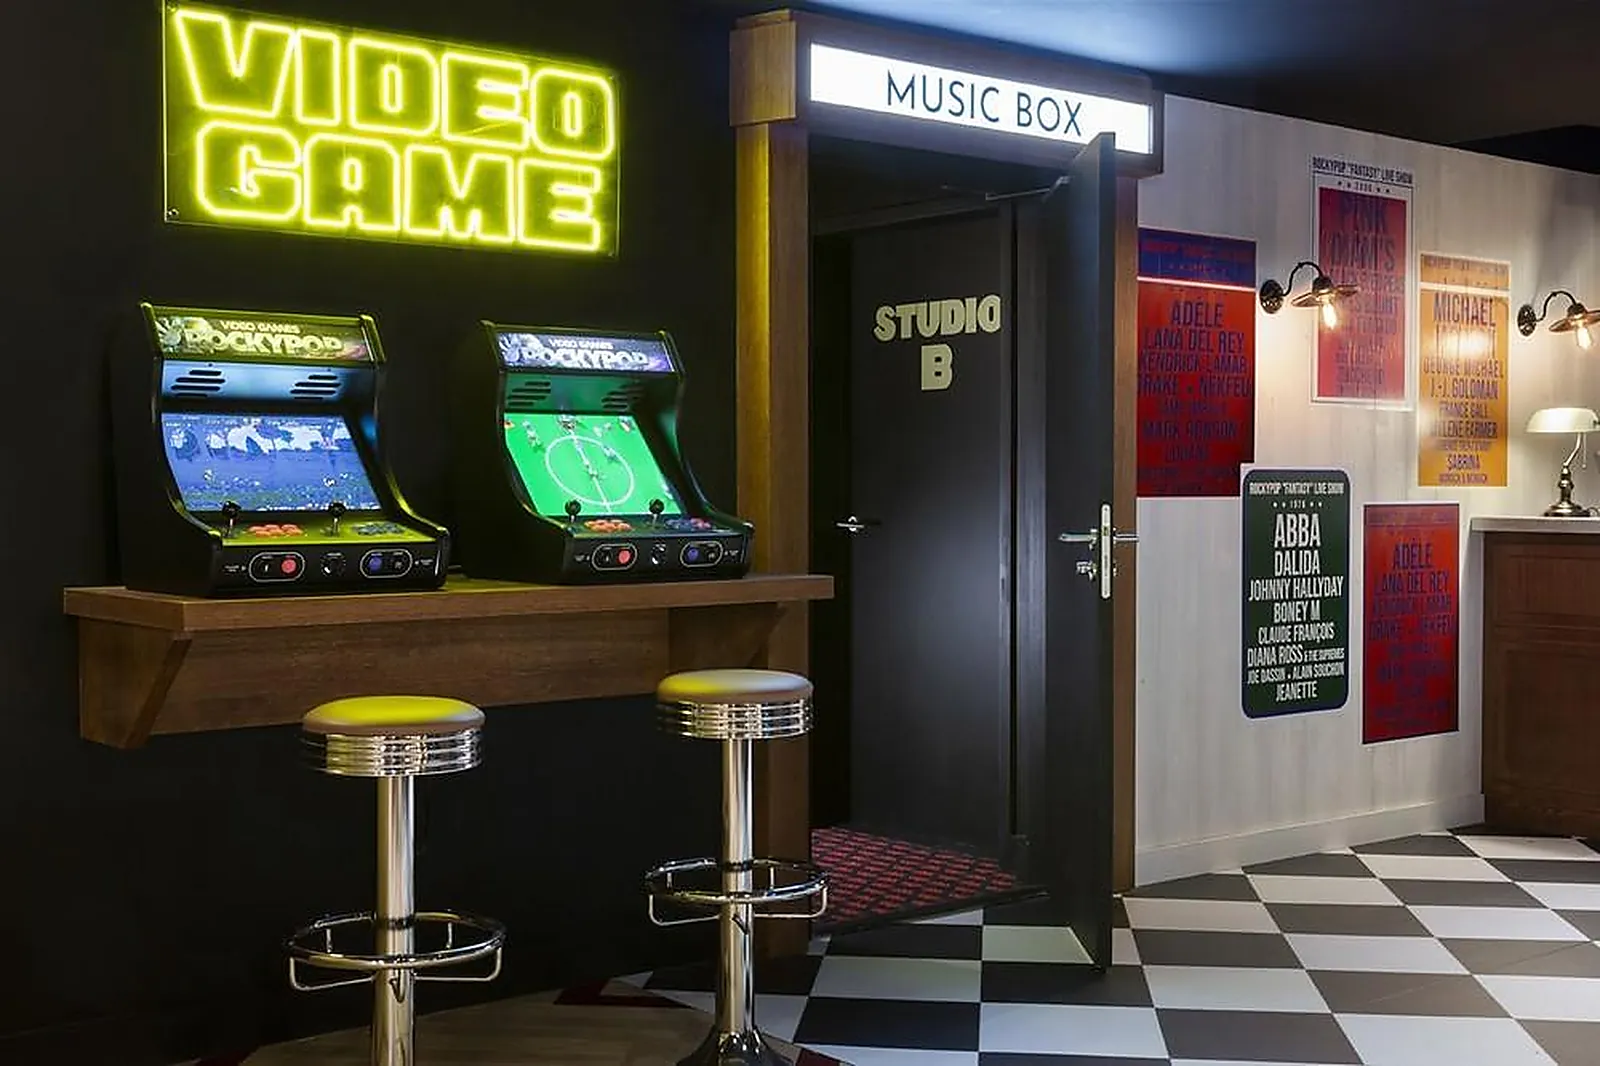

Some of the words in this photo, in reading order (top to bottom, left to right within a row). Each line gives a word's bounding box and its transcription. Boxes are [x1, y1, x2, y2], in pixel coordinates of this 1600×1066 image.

[174, 9, 616, 159] VIDEO
[887, 69, 1000, 123] MUSIC
[1016, 91, 1082, 137] BOX
[196, 119, 602, 252] GAME
[873, 294, 1001, 341] STUDIO
[1433, 291, 1497, 327] MICHAEL
[184, 329, 343, 355] ROCKYPOP
[1144, 326, 1183, 350] LANA
[1188, 329, 1214, 352] DEL
[1217, 330, 1245, 354] REY
[920, 343, 953, 391] B
[1451, 377, 1499, 400] GOLDMAN
[1446, 452, 1481, 471] SABRINA
[1273, 512, 1321, 549] ABBA
[1274, 549, 1321, 577] DALIDA
[1248, 577, 1291, 601] JOHNNY
[1292, 575, 1344, 599] HALLYDAY
[1407, 570, 1426, 594] DEL
[1428, 569, 1451, 593] REY
[1273, 601, 1309, 623] BONEY
[1310, 599, 1321, 621] M
[1257, 624, 1293, 645] CLAUDE
[1293, 621, 1336, 644] FRANÇOIS
[1247, 645, 1278, 667] DIANA
[1278, 644, 1304, 665] ROSS
[1275, 680, 1319, 702] JEANETTE
